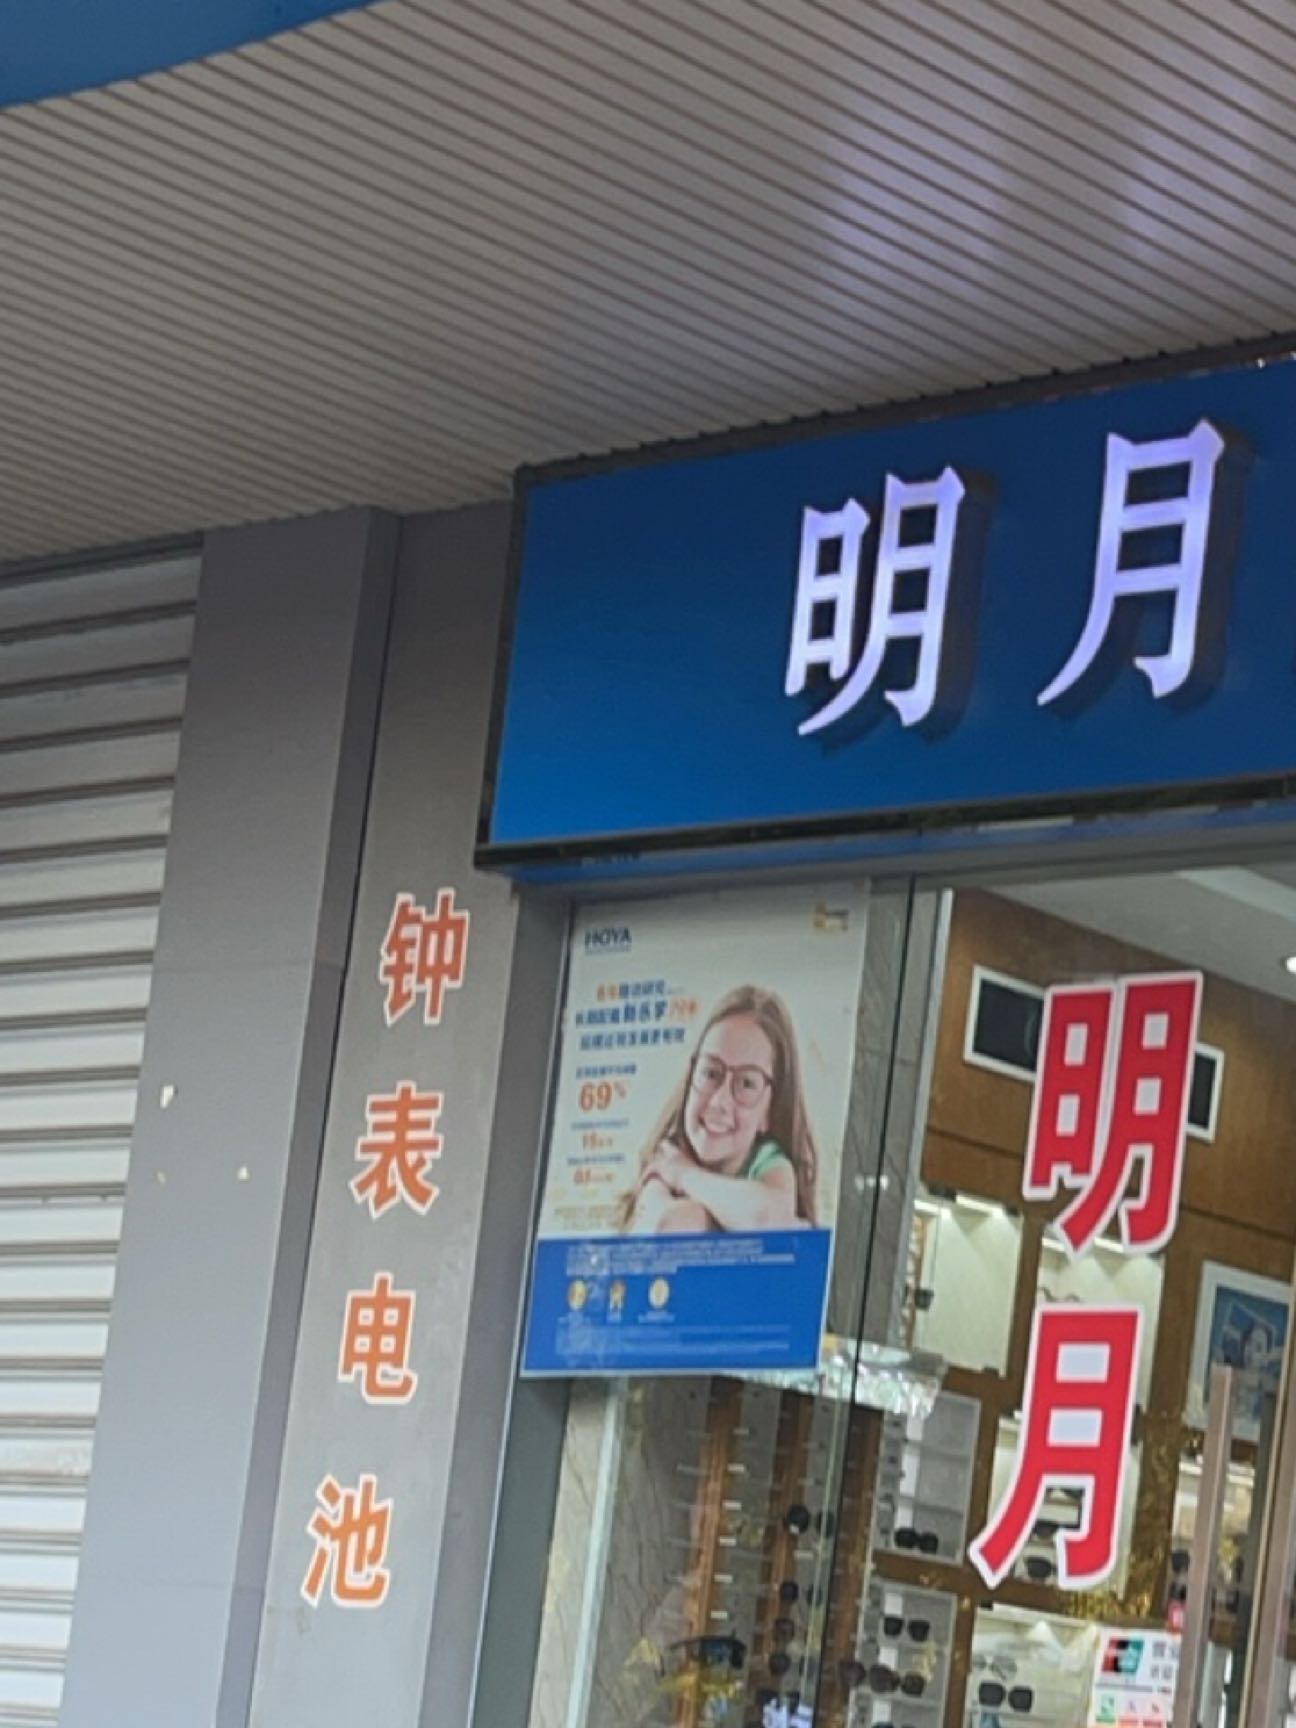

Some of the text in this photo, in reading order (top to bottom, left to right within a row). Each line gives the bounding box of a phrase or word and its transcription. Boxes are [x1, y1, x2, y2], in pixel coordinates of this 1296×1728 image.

[584, 927, 632, 946] HOYA
[303, 888, 470, 1608] 钟表电池
[969, 971, 1202, 1590] 明月
